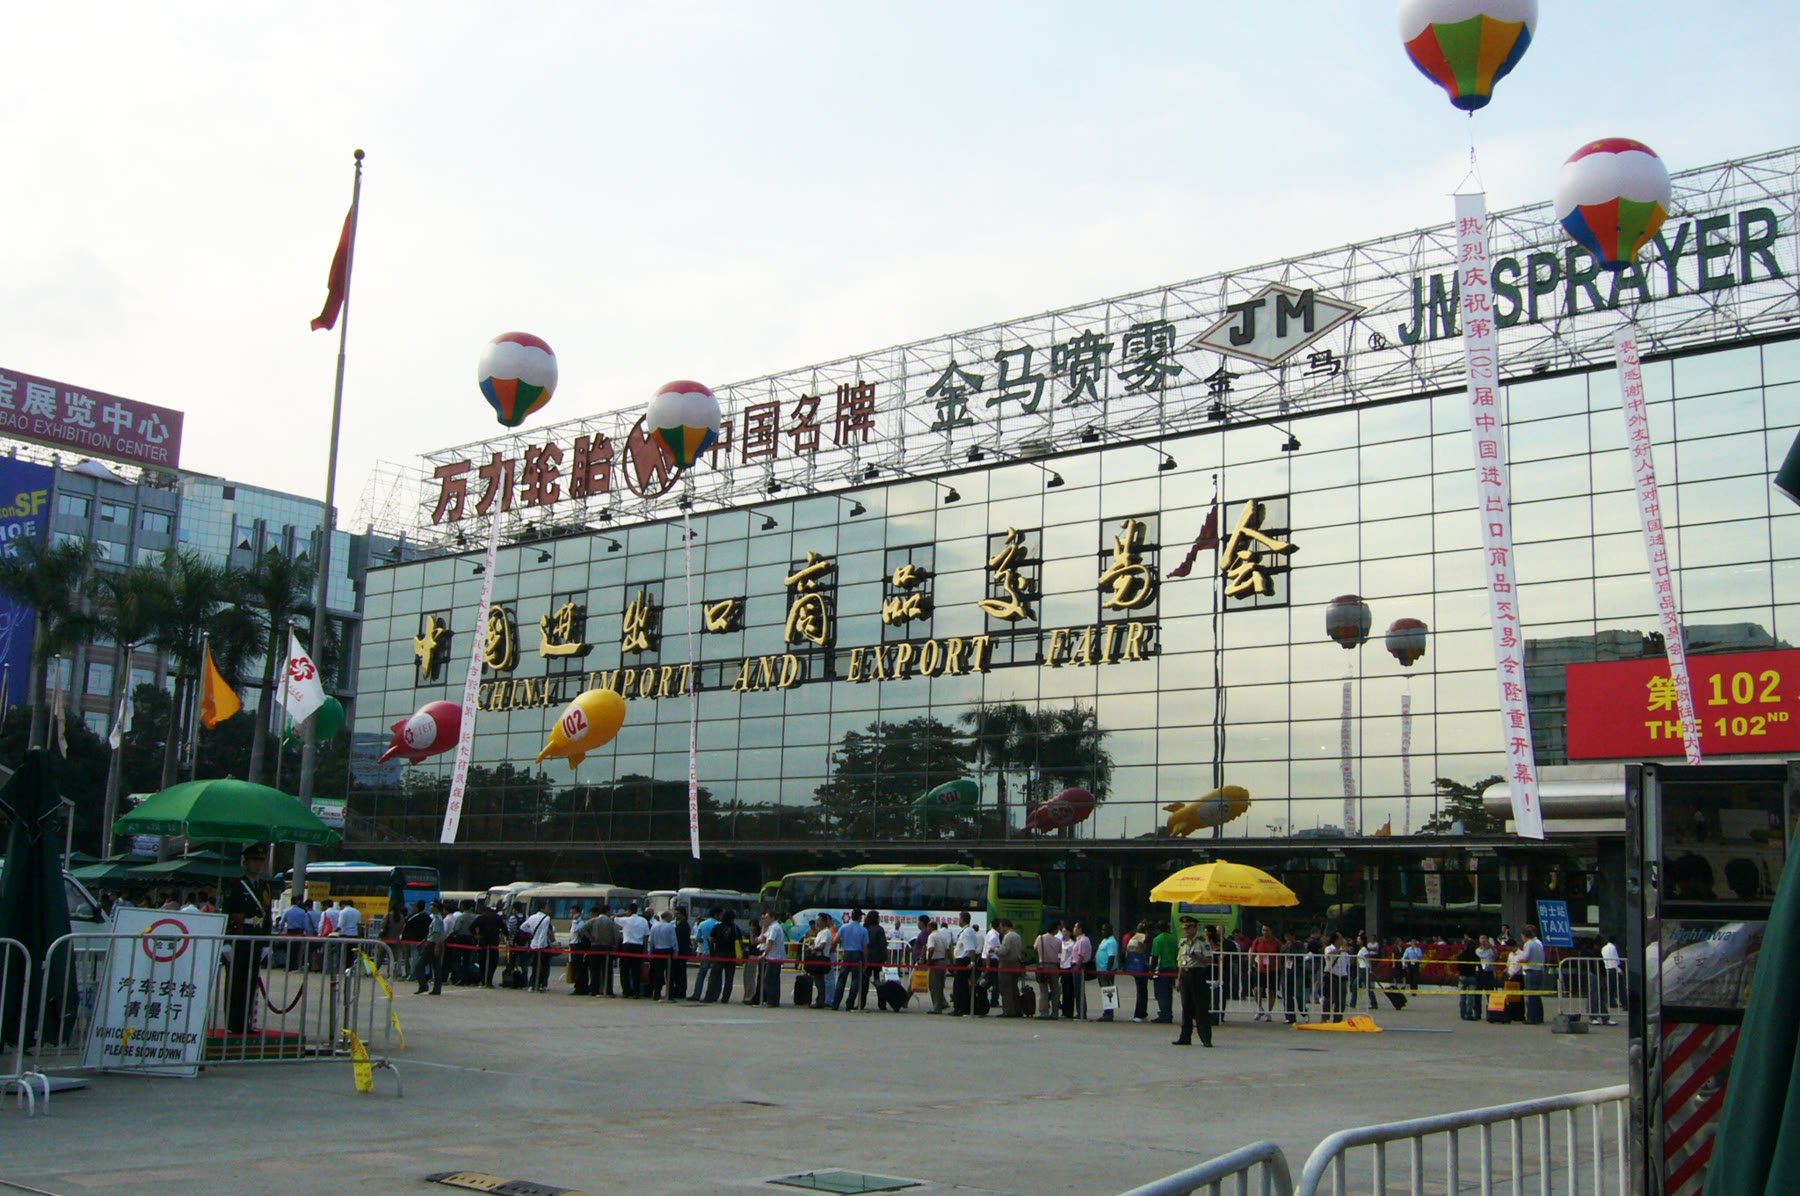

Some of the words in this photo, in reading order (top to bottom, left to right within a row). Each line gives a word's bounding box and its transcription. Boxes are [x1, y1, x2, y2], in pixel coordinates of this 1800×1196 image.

[1492, 206, 1784, 330] SPRAYER
[1227, 288, 1314, 346] JM
[926, 319, 1183, 432] 金马喷雾
[34, 419, 112, 448] EXHIBITION
[116, 438, 168, 463] CENTER
[431, 432, 615, 526] 万力轮胎
[703, 380, 876, 470] 中国名牌
[0, 489, 48, 518] onSF
[477, 676, 550, 711] CHINA
[588, 664, 692, 700] IMPORT
[731, 653, 800, 692] AND
[845, 634, 991, 683] EXPORT
[1044, 621, 1147, 667] FAIR
[1708, 670, 1781, 706] 102
[562, 709, 588, 738] 102
[1539, 904, 1566, 918] 的士站
[1541, 919, 1570, 934] TAXI
[117, 976, 198, 998] 汽车安检
[124, 1000, 183, 1021] 请慢行
[104, 1044, 134, 1057] PLEASE
[134, 1046, 158, 1058] SLOW
[158, 1048, 182, 1060] DOWN
[171, 1032, 198, 1044] CHECK
